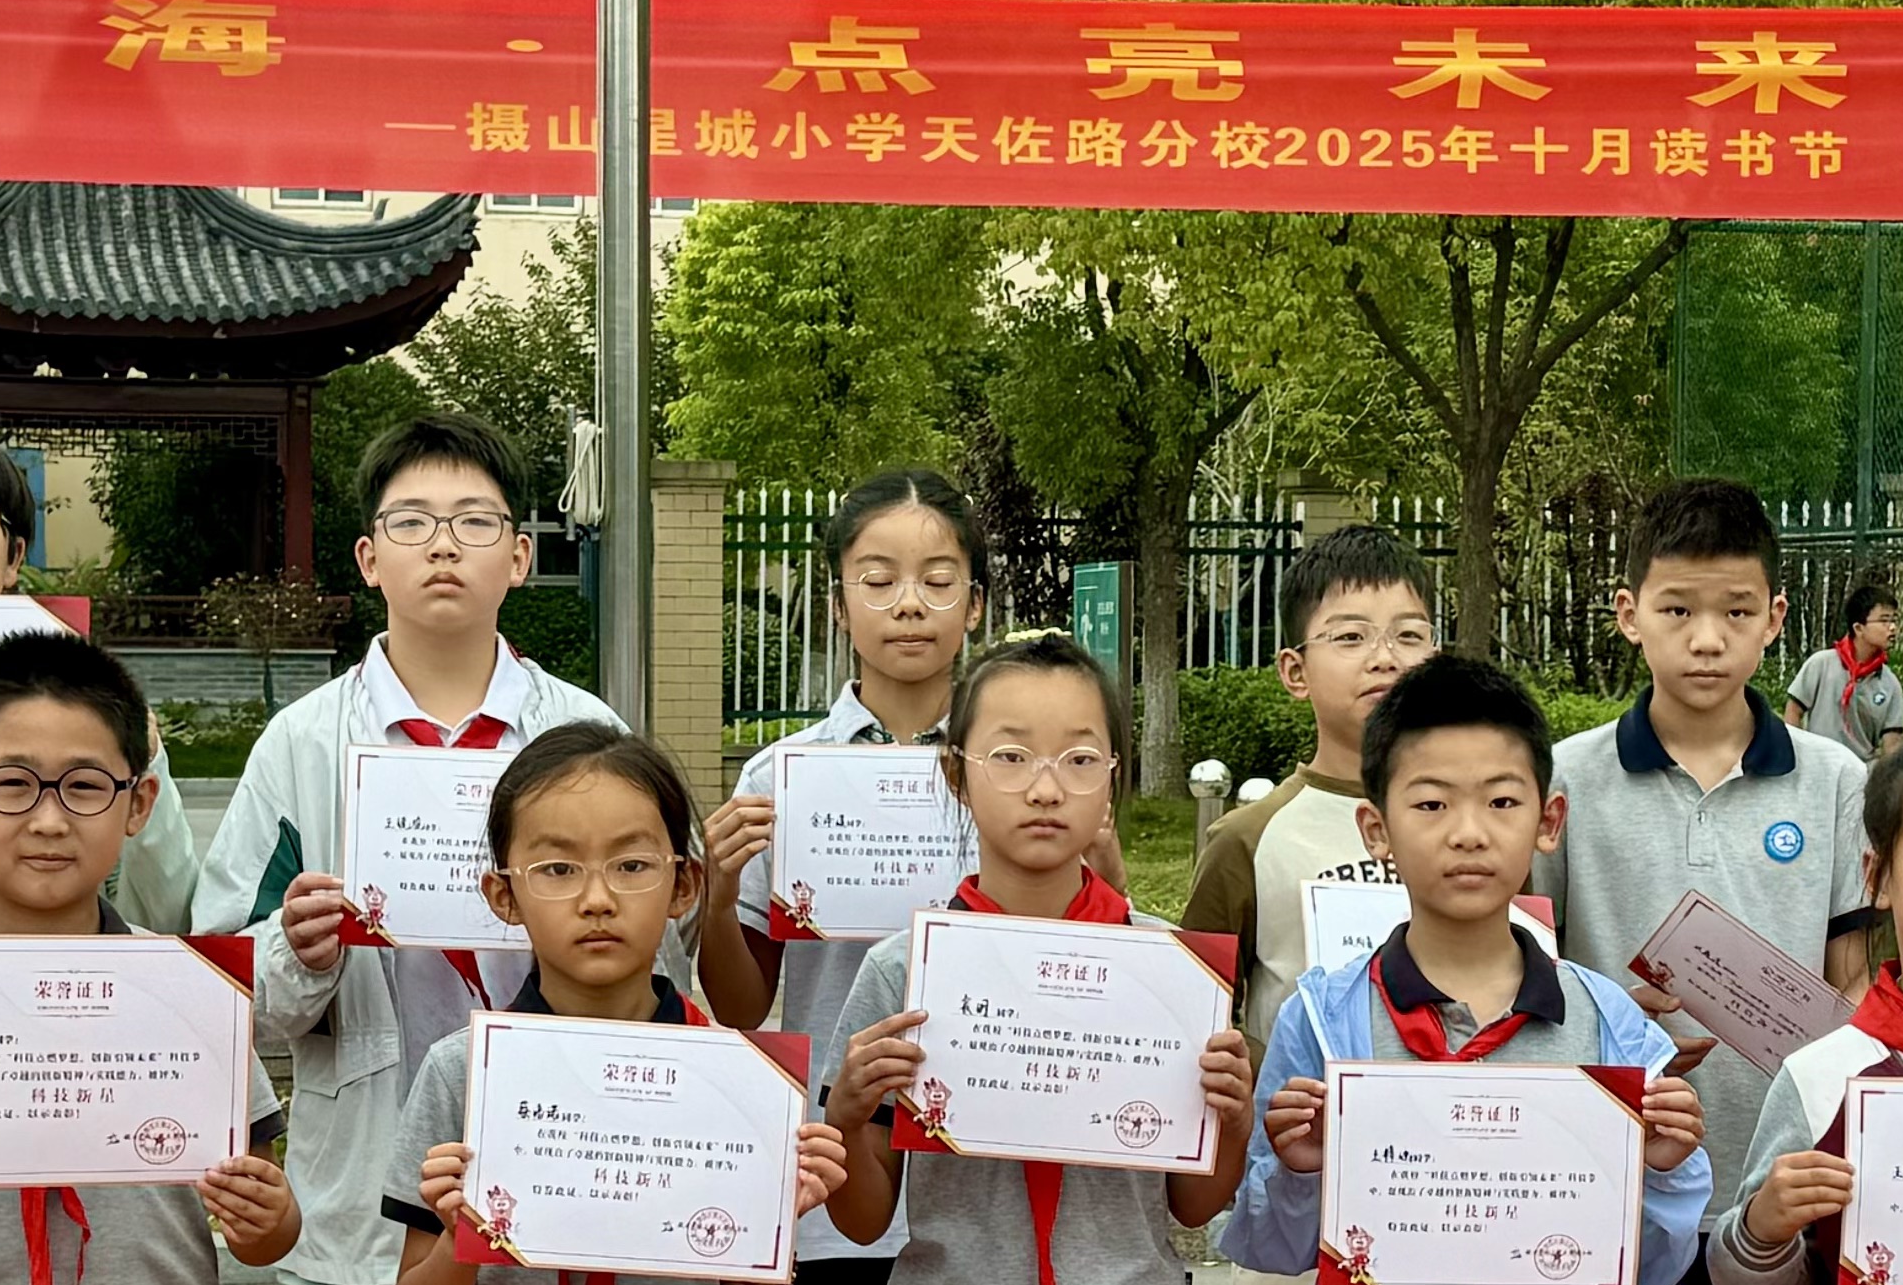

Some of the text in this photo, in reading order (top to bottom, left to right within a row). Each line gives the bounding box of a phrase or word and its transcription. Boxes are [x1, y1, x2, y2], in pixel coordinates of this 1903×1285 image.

[34, 981, 115, 999] 荣誉证书
[31, 1087, 115, 1104] 科技新星
